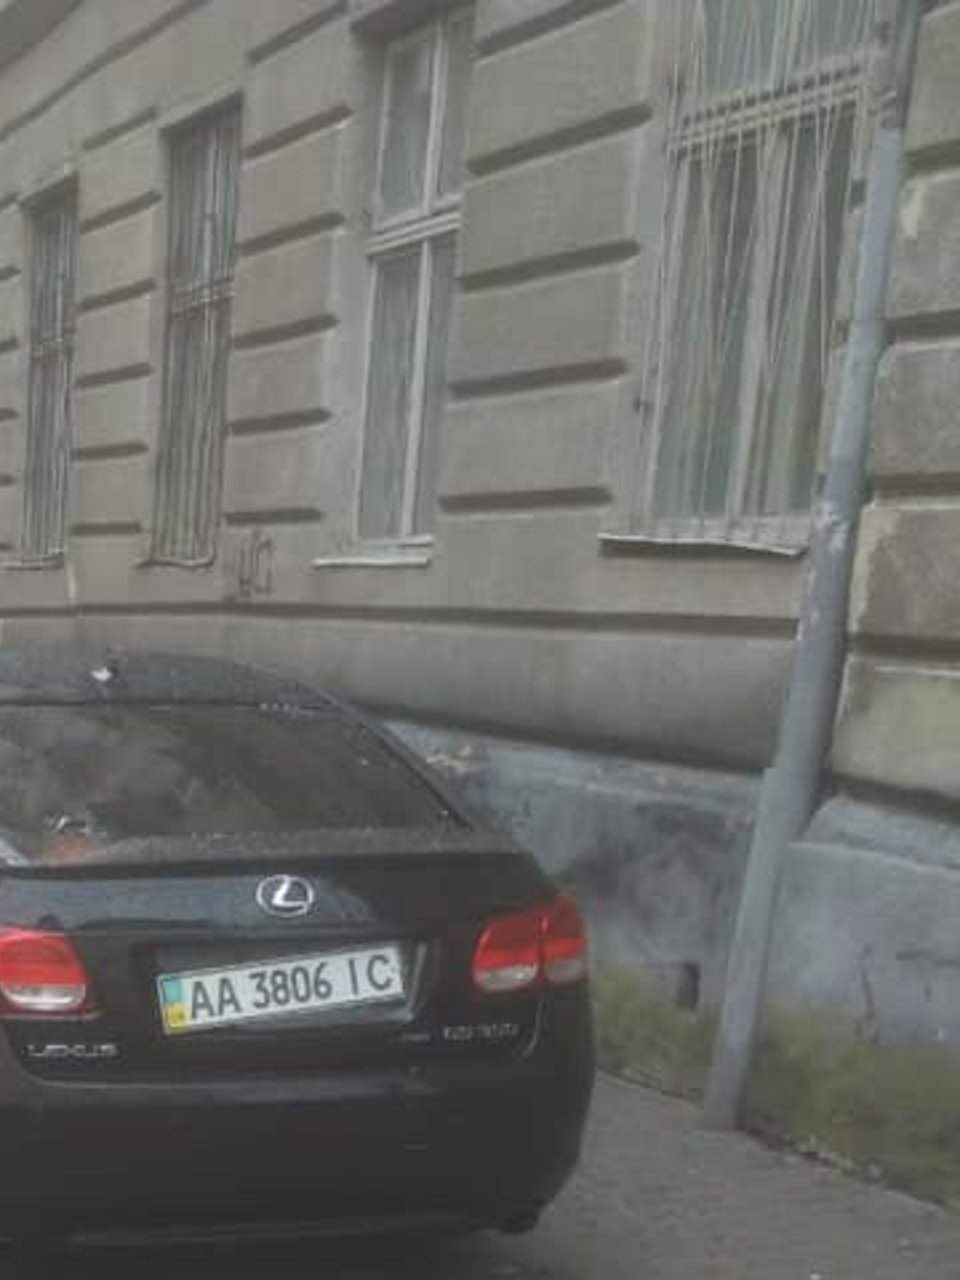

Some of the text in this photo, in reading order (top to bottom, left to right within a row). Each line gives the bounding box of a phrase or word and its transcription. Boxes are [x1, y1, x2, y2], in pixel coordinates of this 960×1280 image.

[191, 954, 393, 1019] AA 3806 IC
